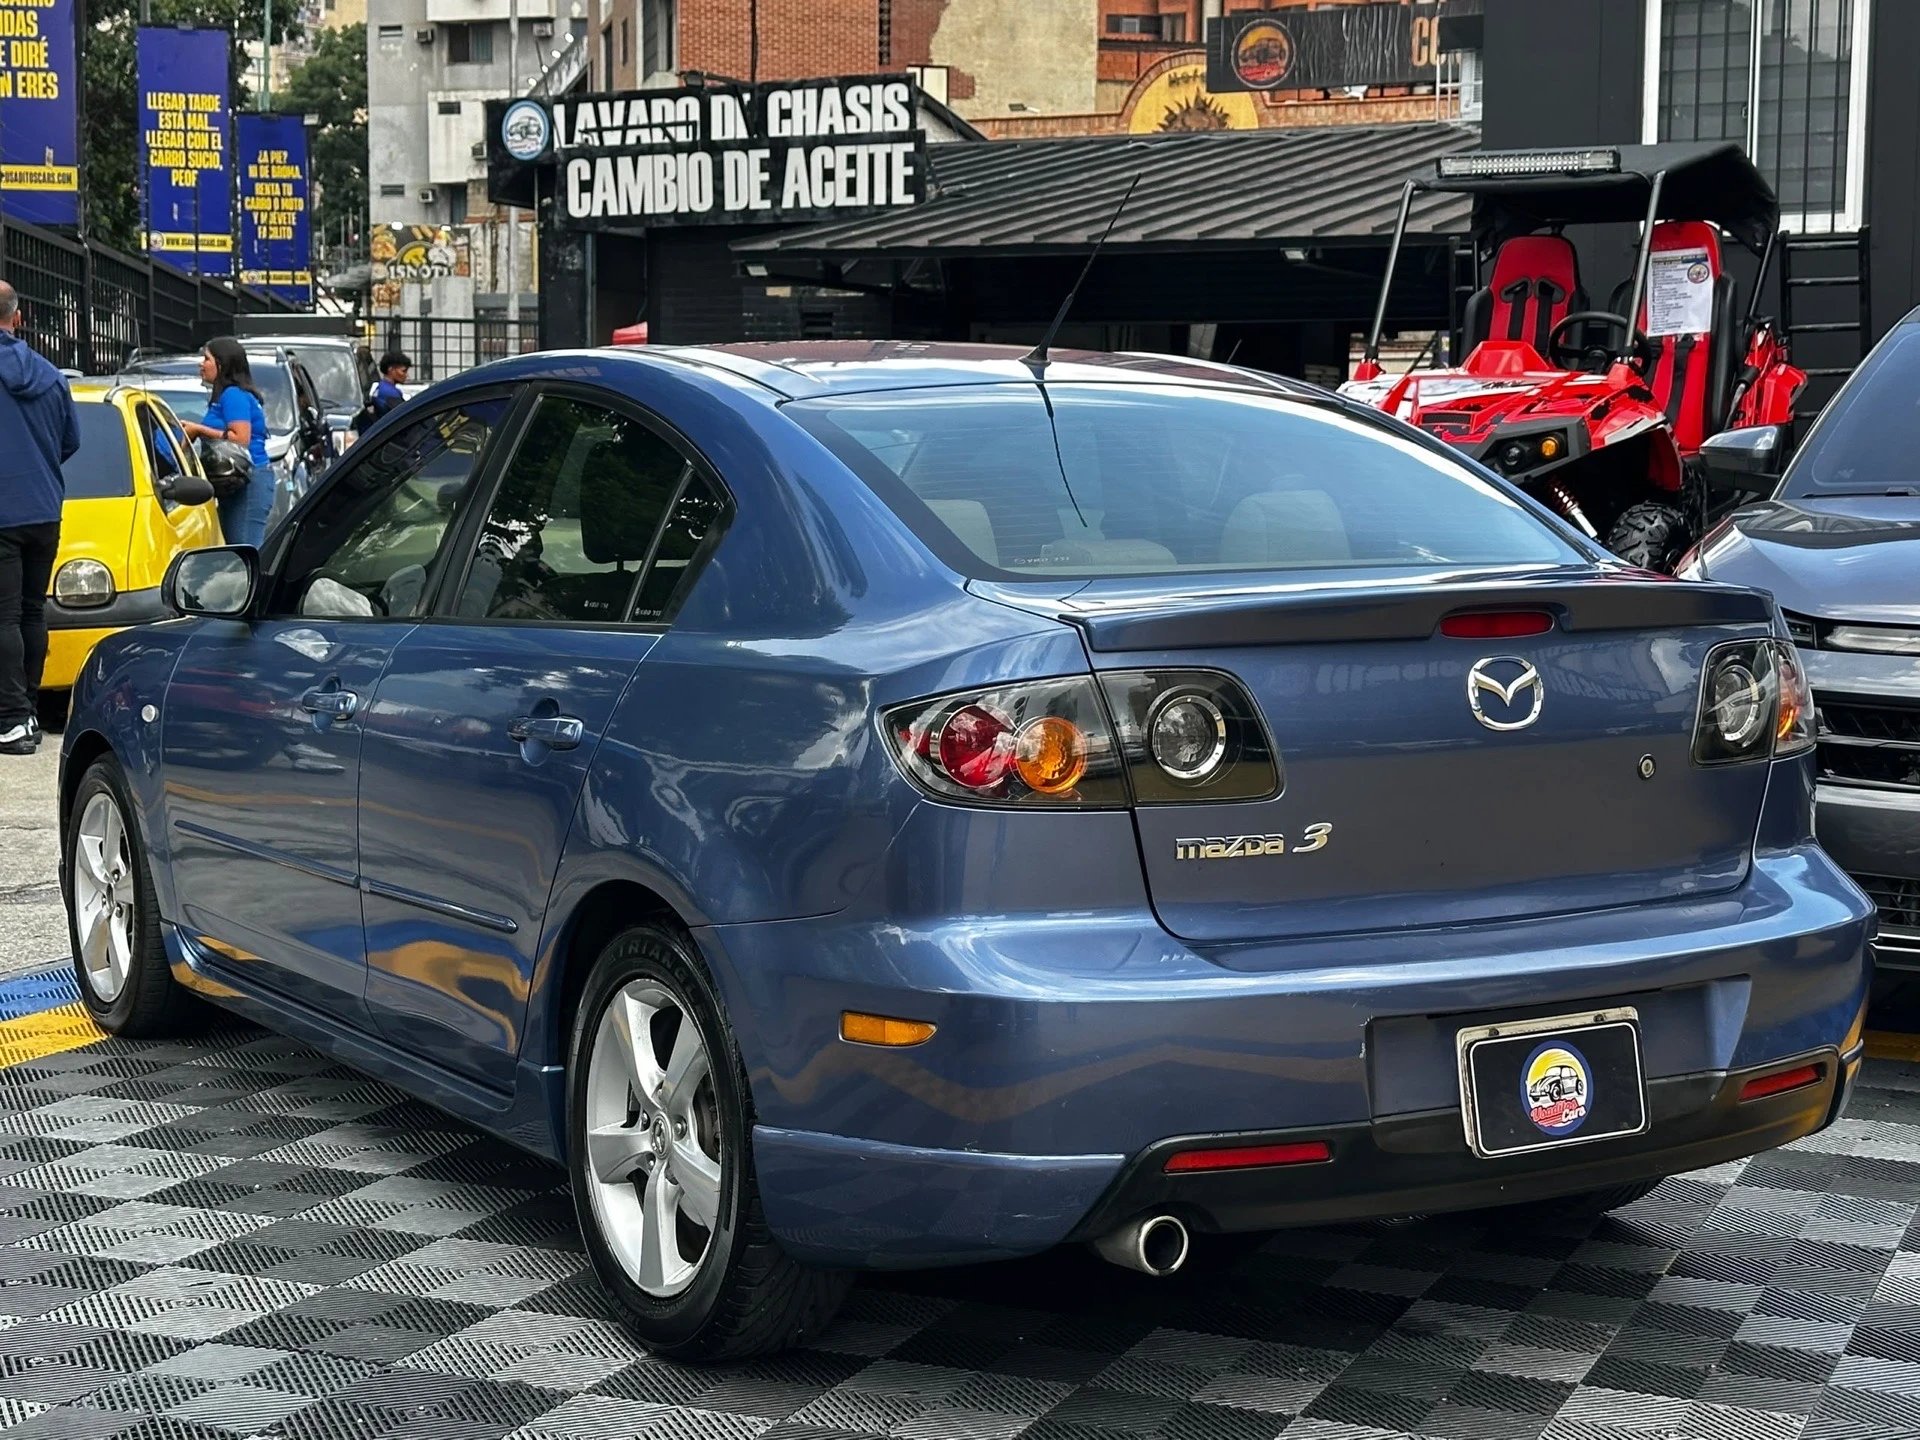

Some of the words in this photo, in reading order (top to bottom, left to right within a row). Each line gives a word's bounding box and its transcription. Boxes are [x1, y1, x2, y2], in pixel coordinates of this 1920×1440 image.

[11, 35, 49, 68] DIRÉ
[17, 71, 58, 99] ERES
[147, 91, 186, 110] LLEGAR
[187, 93, 221, 112] TARDE
[767, 83, 911, 138] CHASIS
[146, 130, 185, 148] LLEGAR
[187, 131, 209, 150] CON
[211, 132, 223, 150] EL
[150, 149, 186, 168] CARRO
[567, 152, 713, 218] CAMBIO
[723, 148, 772, 210] DE
[781, 142, 915, 209] ACEITE
[1292, 822, 1333, 853] 3
[1561, 1106, 1586, 1122] Cars
